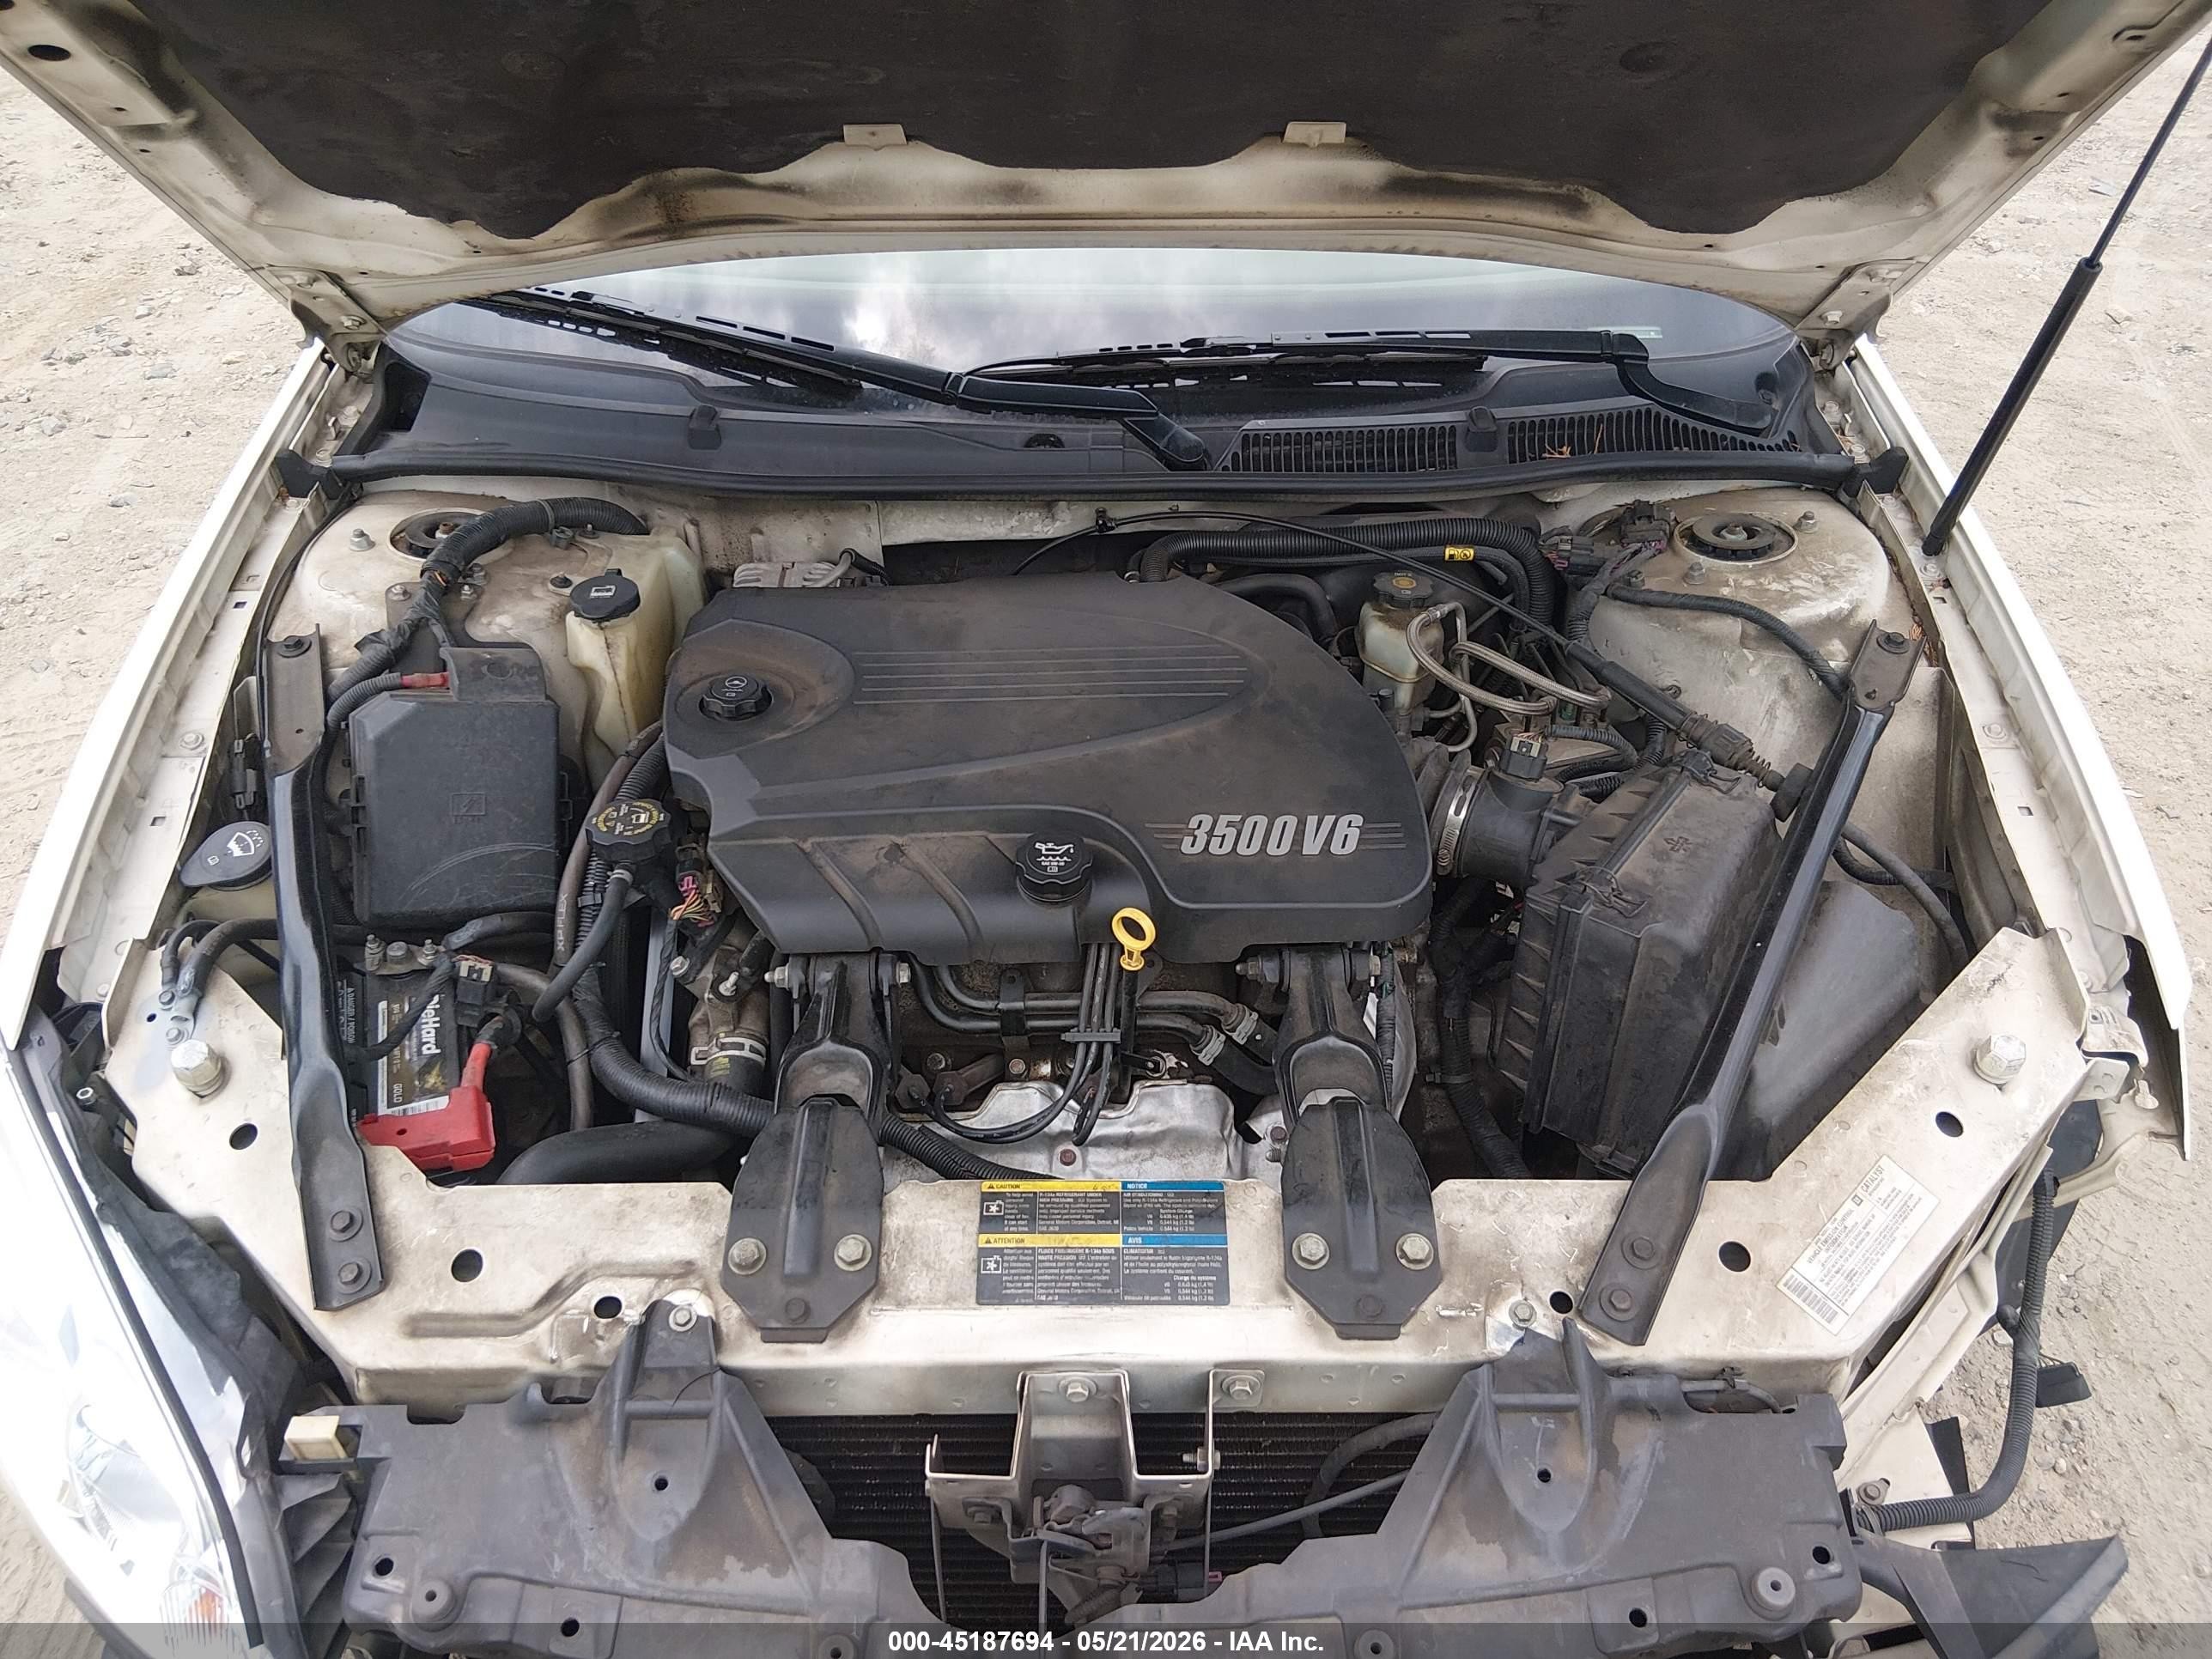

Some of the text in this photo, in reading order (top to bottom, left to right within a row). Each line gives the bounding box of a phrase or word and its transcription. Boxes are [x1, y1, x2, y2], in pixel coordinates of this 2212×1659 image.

[1180, 814, 1364, 856] 3500 V6
[556, 893, 568, 927] FLEX
[347, 994, 356, 1018] DANGER
[392, 1083, 403, 1103] GOLD
[1860, 1164, 1885, 1193] CATALYST
[1820, 1225, 1839, 1247] EMISSION
